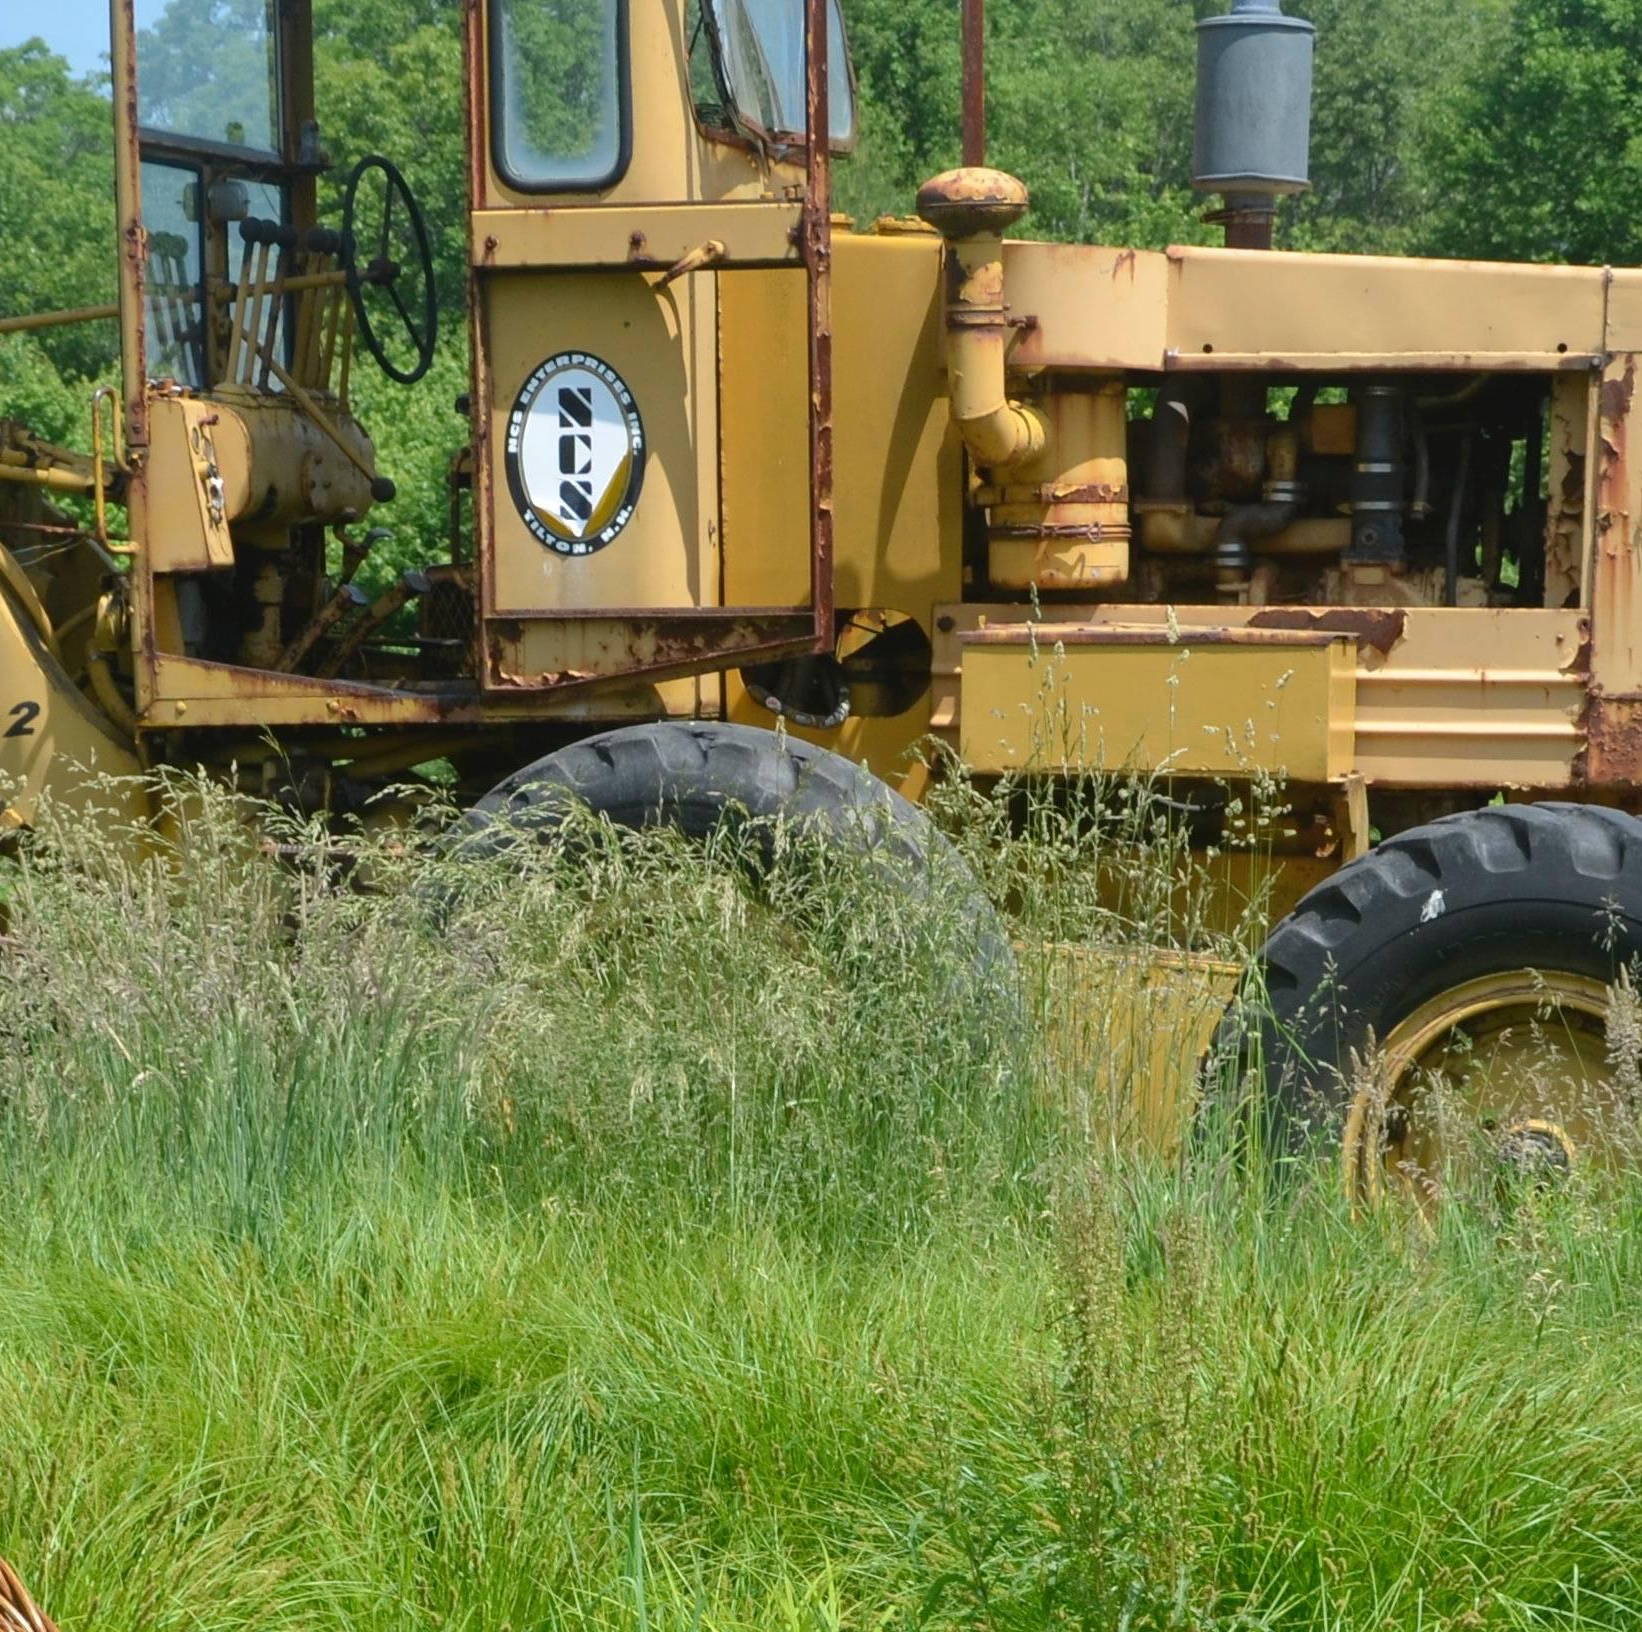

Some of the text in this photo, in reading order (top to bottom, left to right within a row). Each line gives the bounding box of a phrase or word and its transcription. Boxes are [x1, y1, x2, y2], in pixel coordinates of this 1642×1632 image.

[508, 354, 643, 455] NCS ENTERPRISES INC.
[558, 387, 593, 521] NCS
[600, 505, 633, 543] N.H.
